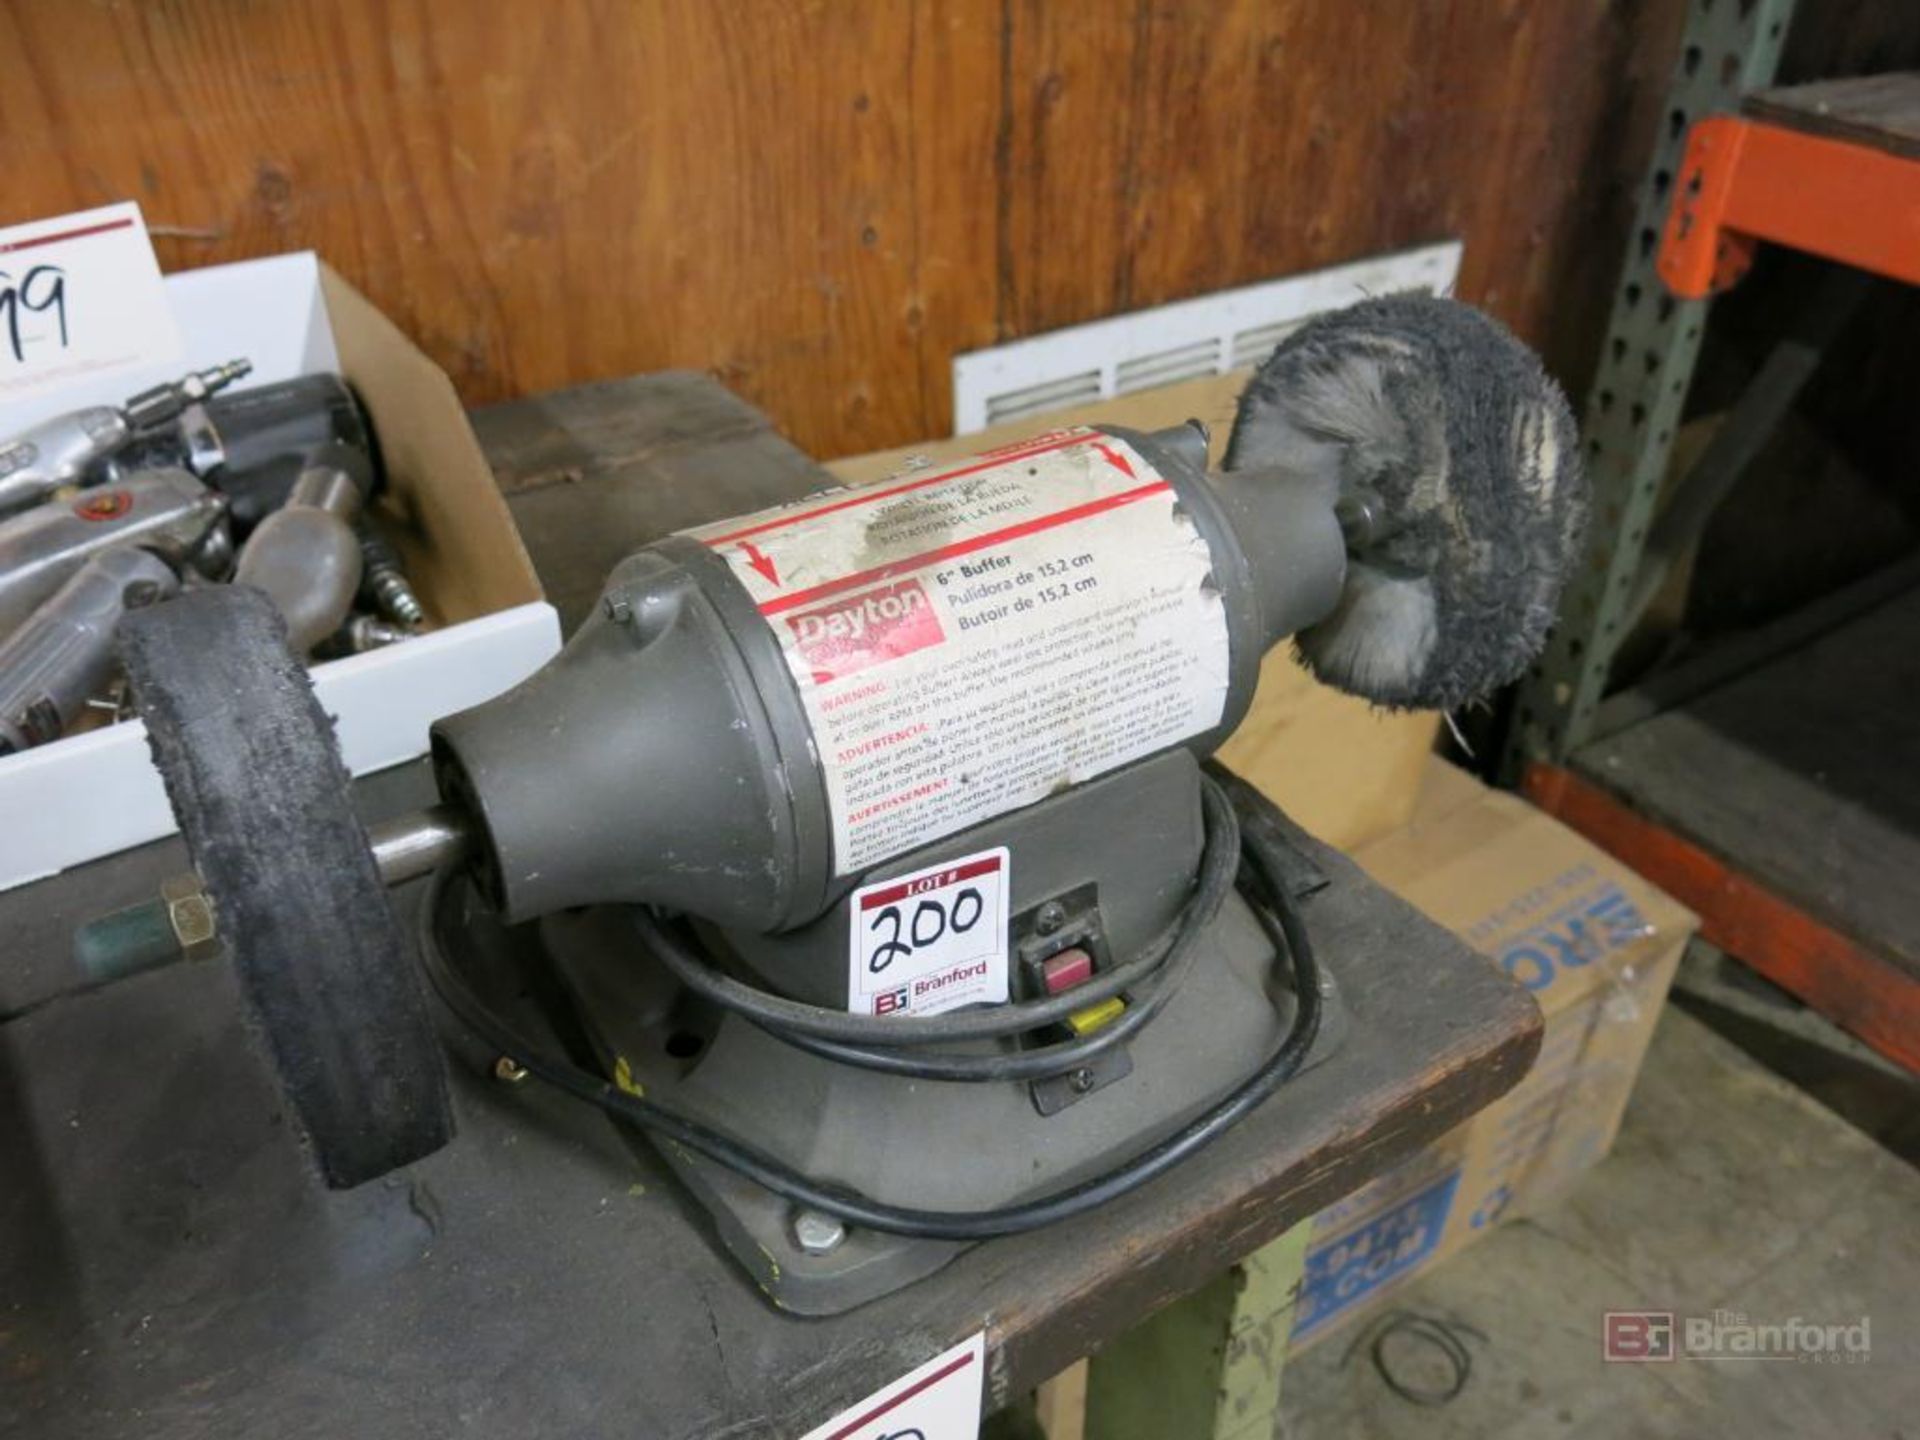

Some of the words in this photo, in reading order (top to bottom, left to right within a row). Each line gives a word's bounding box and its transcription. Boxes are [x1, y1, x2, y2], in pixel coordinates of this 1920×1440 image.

[948, 577, 1013, 608] Pulidora
[1015, 569, 1034, 587] de
[1036, 555, 1073, 580] 15,2
[1074, 551, 1095, 568] cm
[960, 554, 1012, 579] Buffer
[799, 589, 924, 643] Dayton
[958, 604, 1009, 631] Butoir
[1013, 593, 1035, 612] de
[1038, 582, 1071, 605] 15,2
[1074, 576, 1098, 592] cm
[907, 875, 944, 896] LOT
[947, 870, 959, 884] #
[869, 887, 984, 974] 200
[914, 960, 988, 996] Branford
